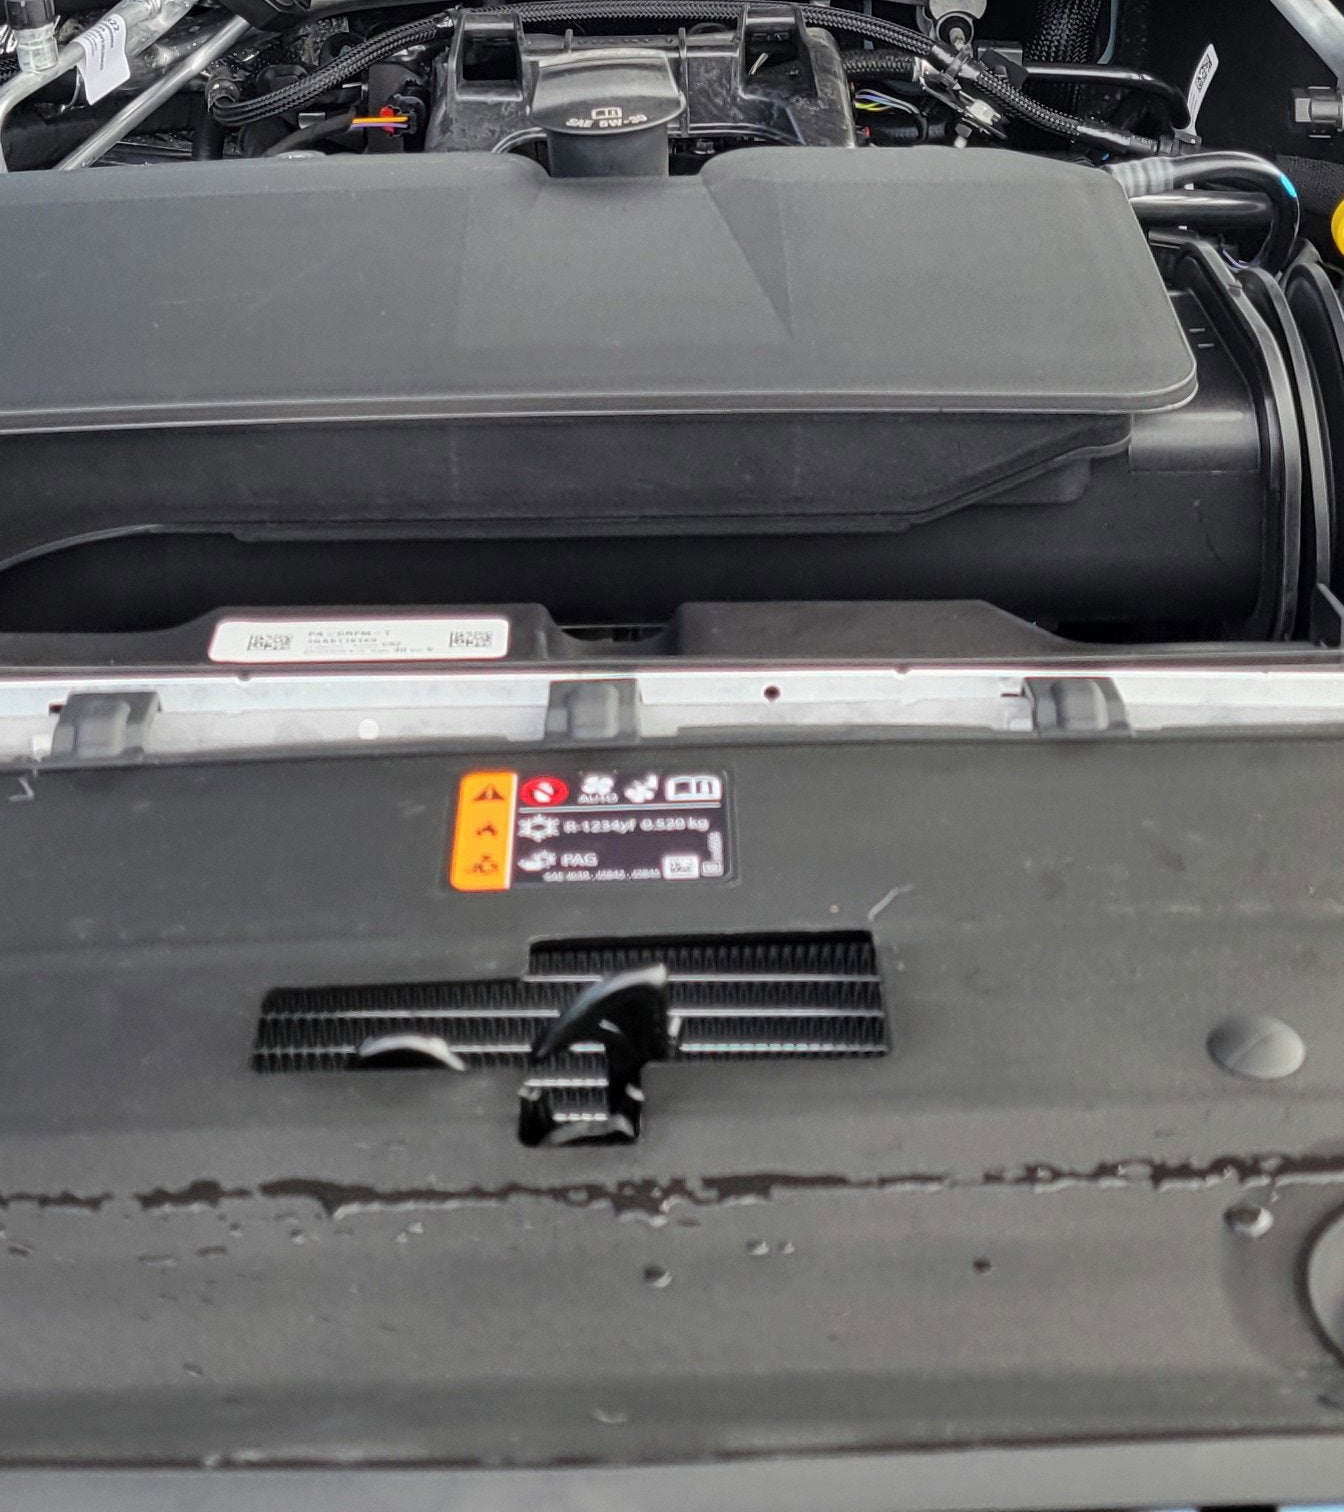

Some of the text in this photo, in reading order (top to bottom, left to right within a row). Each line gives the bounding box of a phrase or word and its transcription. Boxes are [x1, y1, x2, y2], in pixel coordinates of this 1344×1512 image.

[566, 118, 594, 128] SAE
[578, 793, 619, 804] AUTO
[563, 816, 710, 834] R-1234yf 0.520 kg
[560, 852, 599, 867] PAG
